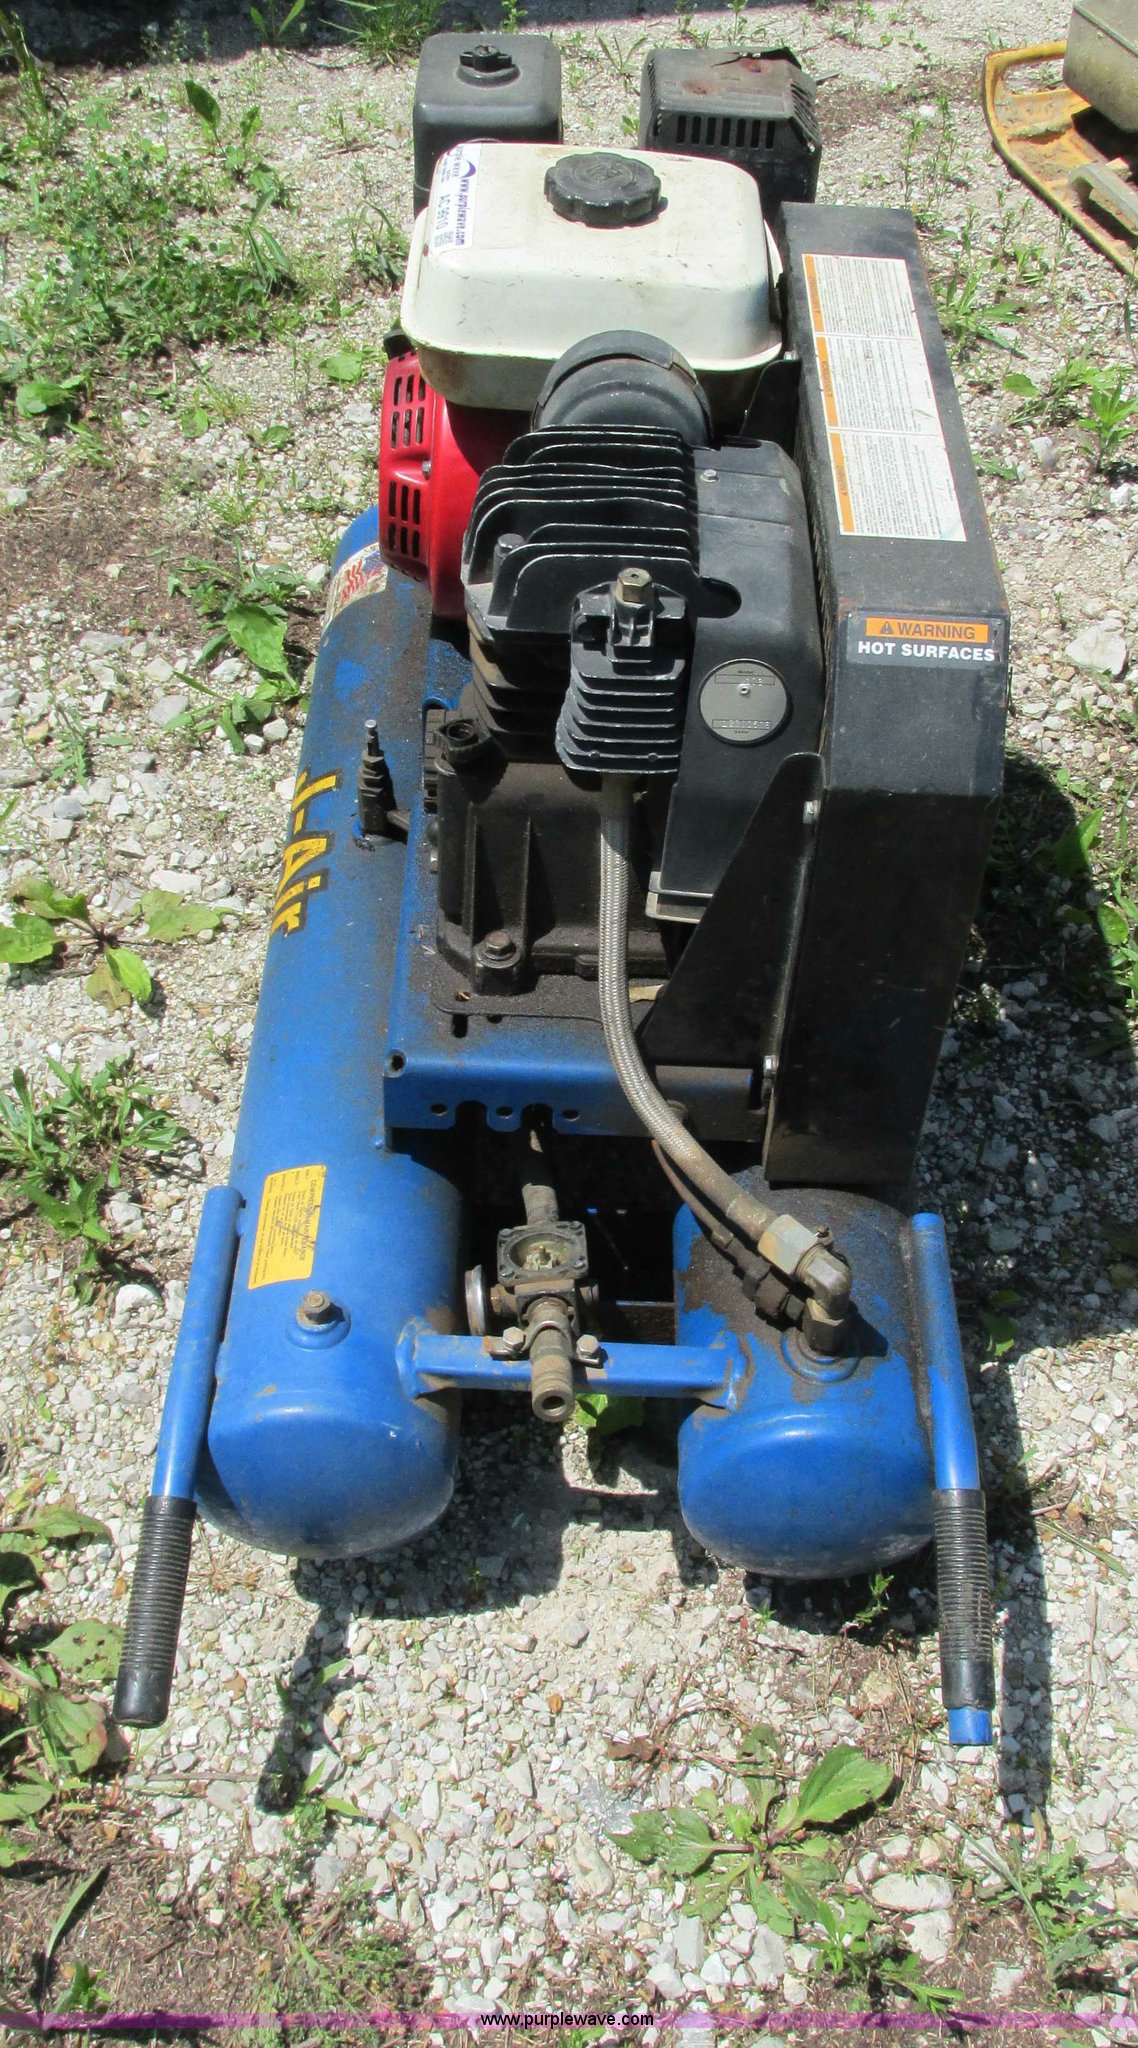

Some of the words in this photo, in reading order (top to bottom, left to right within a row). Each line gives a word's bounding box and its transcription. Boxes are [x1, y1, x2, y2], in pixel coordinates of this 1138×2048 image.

[897, 622, 976, 640] WARNING
[858, 641, 896, 655] HOT
[901, 643, 996, 662] SURFACES
